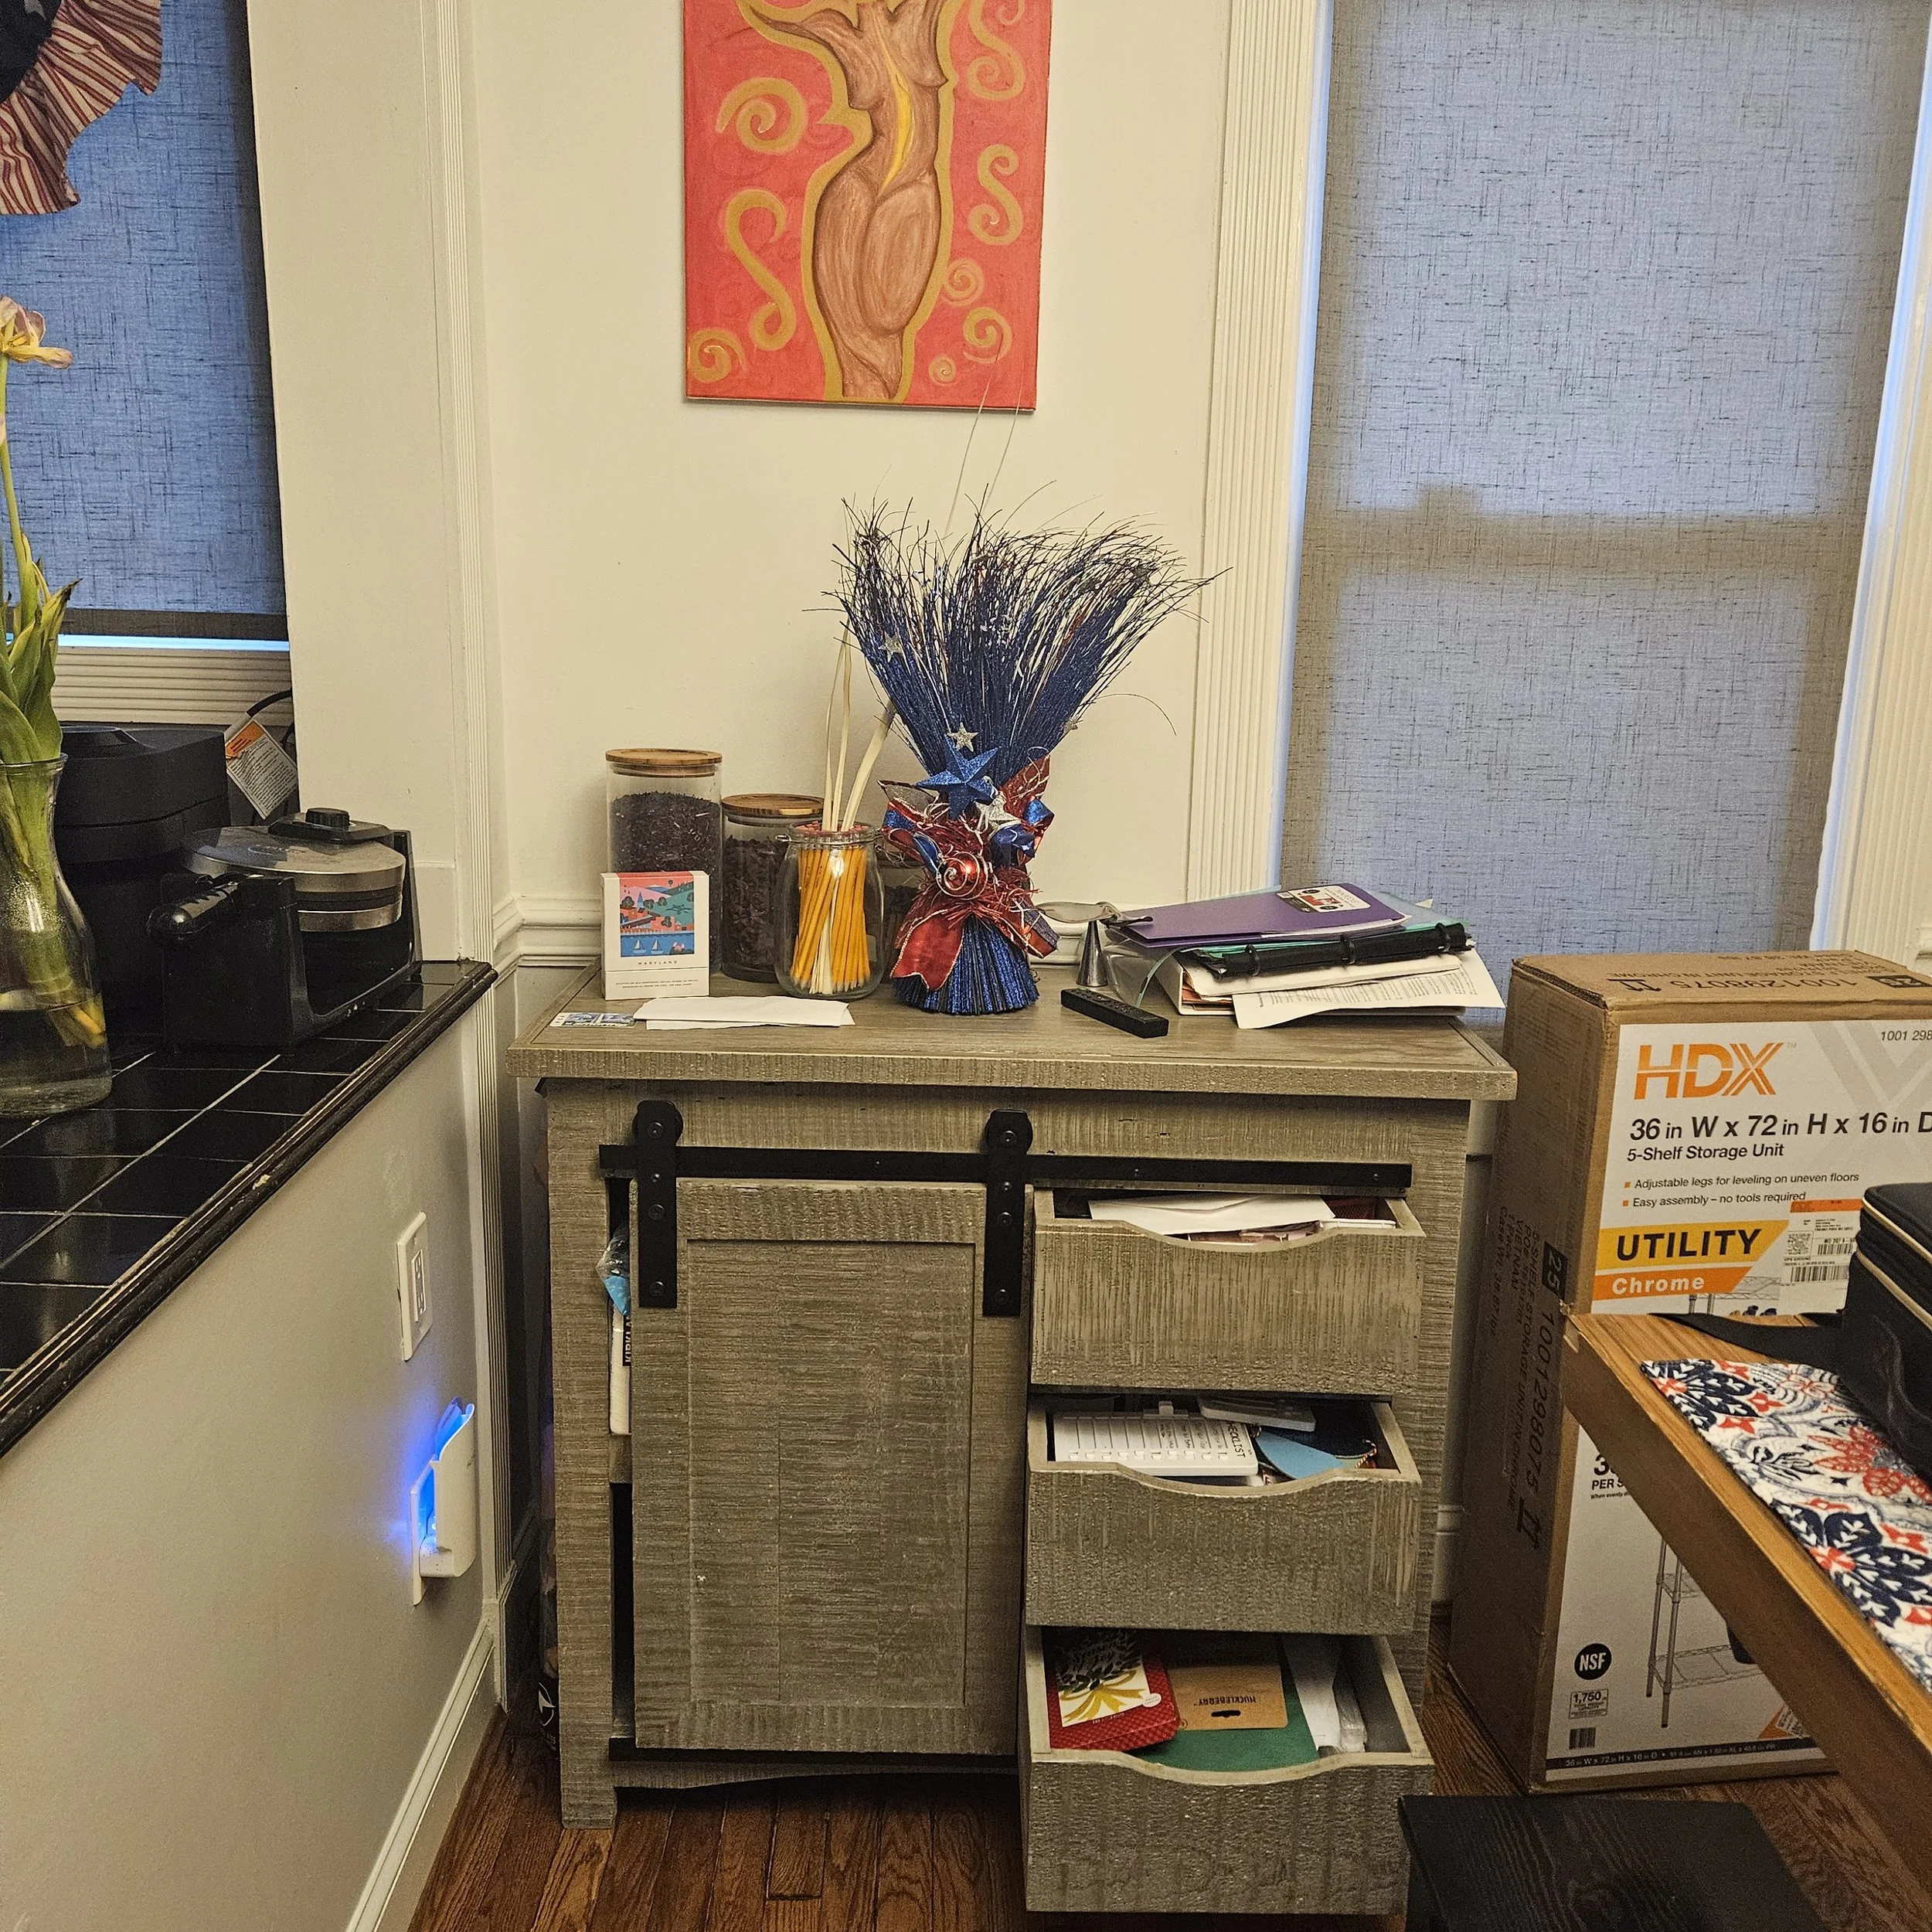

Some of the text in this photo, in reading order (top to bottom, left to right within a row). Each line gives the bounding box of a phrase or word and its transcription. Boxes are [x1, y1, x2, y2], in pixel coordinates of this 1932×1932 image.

[1670, 978, 1858, 988] 1001298075
[1880, 1029, 1932, 1041] 1001 298
[1634, 1043, 1784, 1100] HDX
[1630, 1111, 1932, 1141] 36 in W x 72 in H x 16 in D
[1627, 1144, 1784, 1162] 5-Shelf Storage Unit
[1634, 1172, 1859, 1190] Adjustable legs for leveling on uneven floors
[1633, 1197, 1658, 1209] Easy
[1660, 1195, 1709, 1207] assembly
[1736, 1192, 1762, 1203] tools
[1764, 1192, 1806, 1204] required
[1498, 1206, 1508, 1243] Case
[1505, 1224, 1515, 1260] Pack
[1511, 1219, 1524, 1290] VIETNAM
[1617, 1228, 1763, 1262] UTILITY
[1527, 1232, 1540, 1301] 5-SHELF
[1546, 1250, 1562, 1291] 25
[1612, 1276, 1706, 1296] Chrome
[1519, 1302, 1533, 1381] STORAGE
[1515, 1382, 1526, 1420] UNIT
[1526, 1311, 1556, 1488] 1001298075
[1226, 1420, 1246, 1458] HECKLIST
[1592, 1479, 1614, 1490] PER
[1579, 1652, 1607, 1672] NSF
[1199, 1696, 1257, 1706] HUCKLEBERRY
[1573, 1691, 1601, 1703] 1,750
